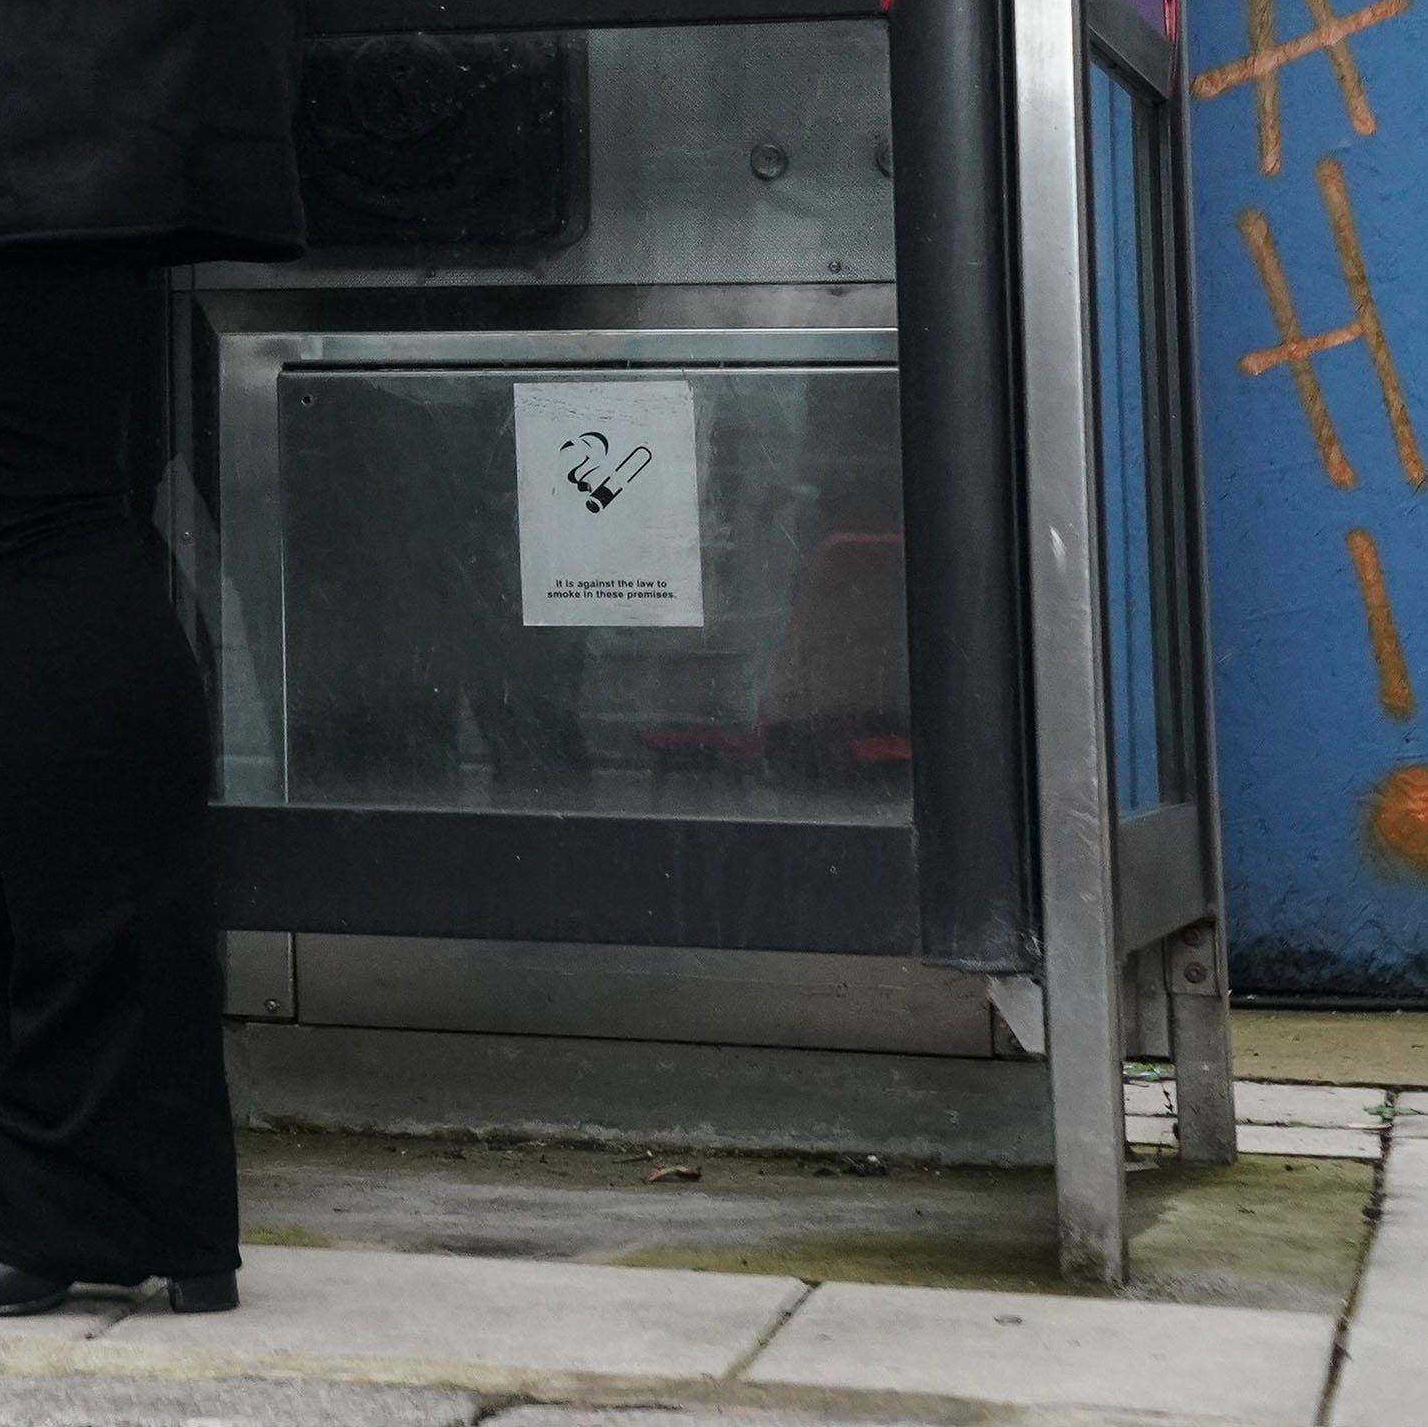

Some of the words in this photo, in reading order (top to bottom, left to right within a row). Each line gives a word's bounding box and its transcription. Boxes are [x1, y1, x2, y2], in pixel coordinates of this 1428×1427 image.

[555, 579, 563, 588] It
[565, 579, 575, 588] is
[577, 579, 615, 590] against
[617, 579, 634, 588] the
[636, 579, 655, 588] law
[657, 579, 667, 588] to
[547, 590, 581, 599] smoke
[583, 589, 594, 599] in
[595, 589, 624, 599] these
[626, 589, 677, 601] premises.
